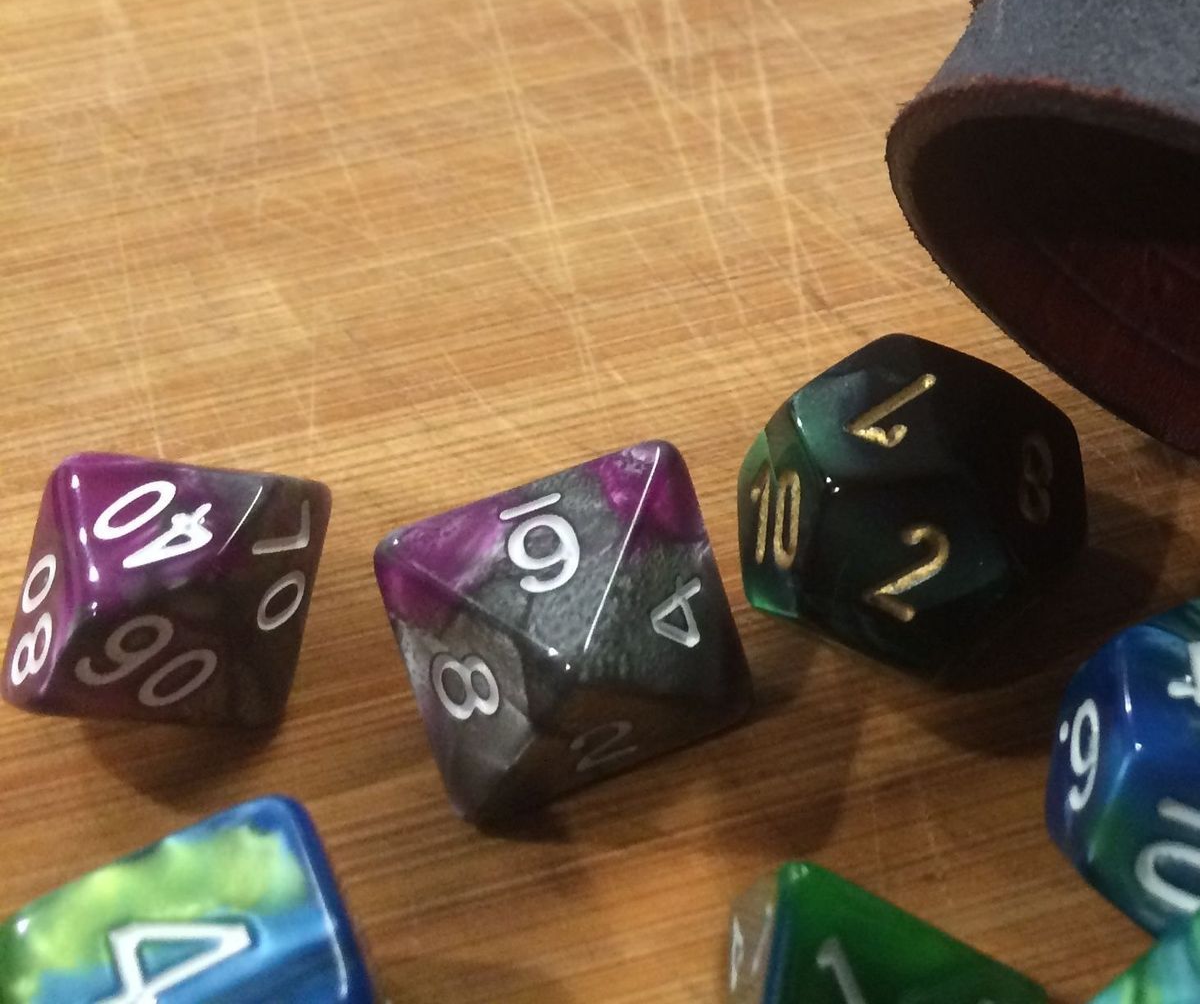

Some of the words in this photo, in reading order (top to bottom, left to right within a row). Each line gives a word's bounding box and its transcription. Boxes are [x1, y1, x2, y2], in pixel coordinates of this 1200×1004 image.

[751, 460, 801, 570] 10
[1017, 428, 1054, 525] 8
[94, 481, 213, 569] 40
[650, 576, 701, 648] 4
[863, 522, 950, 623] 2
[10, 553, 57, 686] 80
[432, 652, 500, 721] 8
[569, 720, 639, 773] 2
